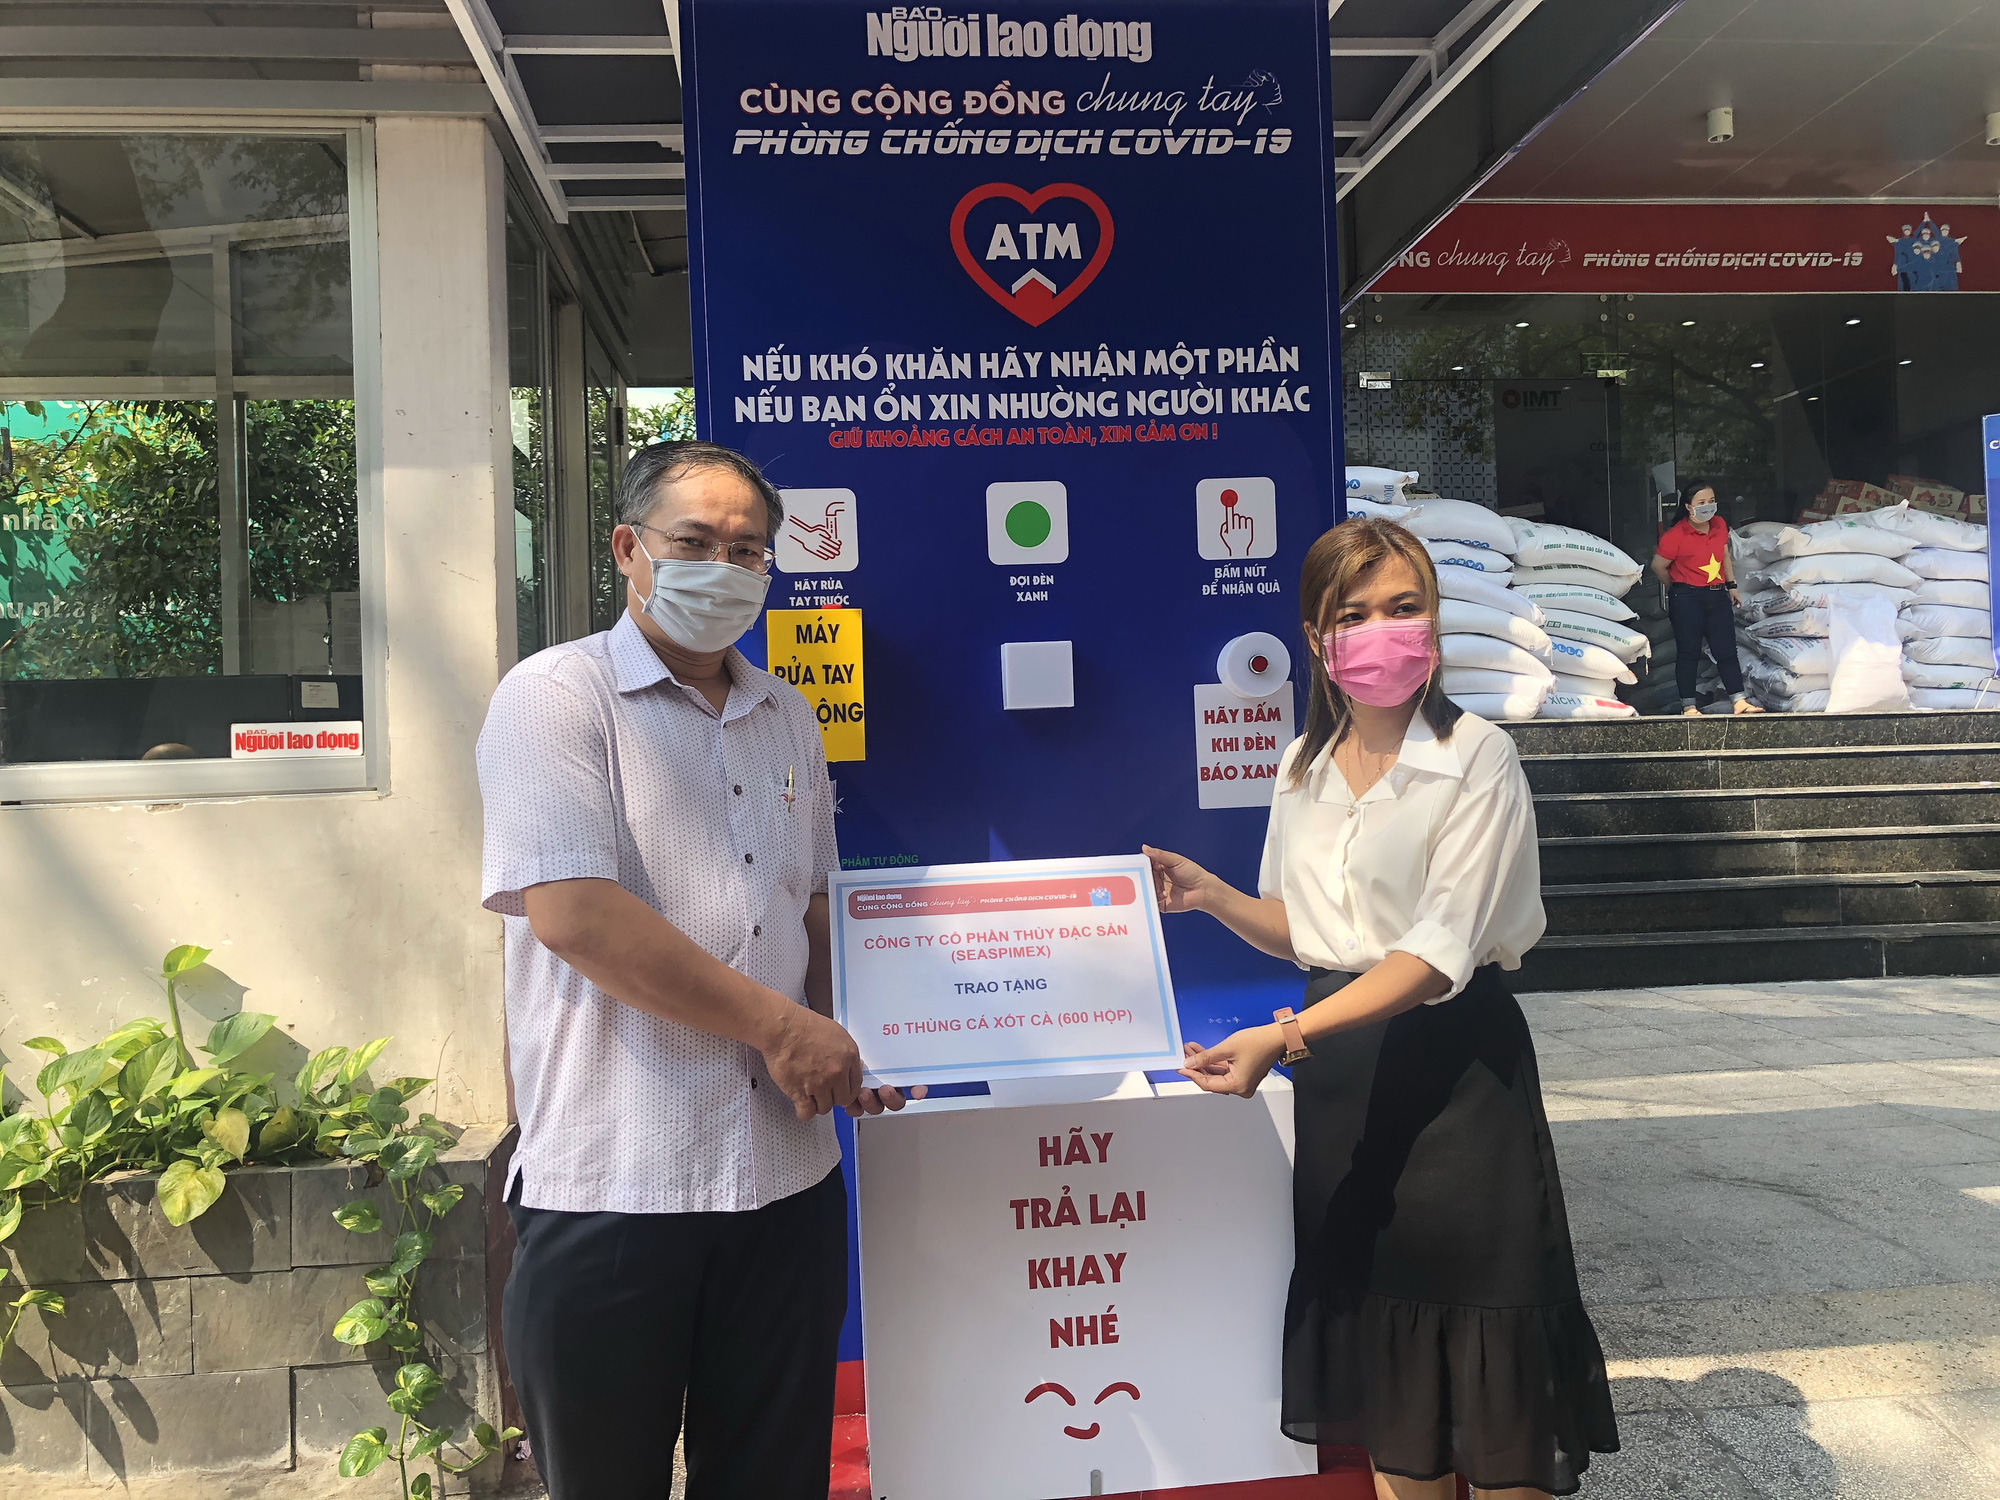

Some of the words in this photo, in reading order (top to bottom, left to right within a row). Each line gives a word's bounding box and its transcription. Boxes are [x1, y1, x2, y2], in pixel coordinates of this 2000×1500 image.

[892, 6, 942, 20] BÁO
[866, 13, 981, 62] Người
[986, 14, 1048, 58] lao
[1053, 14, 1153, 63] động
[739, 82, 841, 115] CÙNG
[851, 83, 953, 122] CỘNG
[963, 79, 1066, 115] ĐỒNG
[1076, 71, 1188, 126] chung
[1197, 75, 1258, 126] tay
[732, 121, 870, 155] PHÒNG
[880, 118, 1012, 155] CHỐNG
[1014, 129, 1105, 162] DỊCH
[1109, 128, 1293, 155] COVID-19
[985, 223, 1083, 261] ATM
[1391, 250, 1430, 267] NG
[1437, 239, 1510, 275] chung
[1515, 242, 1555, 275] tay
[1583, 250, 1650, 267] PHÒNG
[1655, 247, 1720, 267] CHỐNG
[1722, 252, 1767, 270] DỊCH
[1768, 252, 1864, 267] COVID-19
[742, 343, 801, 381] NẾU
[810, 346, 878, 381] KHÓ
[886, 346, 972, 380] KHĂN
[979, 345, 1043, 379] HÃY
[1050, 343, 1136, 382] NHẬN
[1144, 341, 1210, 380] MỘT
[1217, 336, 1299, 374] PHẦN
[734, 385, 793, 423] NẾU
[801, 394, 866, 427] BẠN
[873, 382, 921, 421] ỔN
[929, 393, 980, 421] XIN
[988, 384, 1119, 420] NHƯỜNG
[1127, 381, 1224, 417] NGƯỜI
[1231, 379, 1311, 414] KHÁC
[1523, 391, 1561, 407] IMT
[828, 426, 863, 448] GIỮ
[866, 424, 950, 448] KHOẢNG
[954, 424, 1003, 446] CÁCH
[1006, 427, 1034, 446] AN
[1037, 422, 1096, 447] TOÀN,
[1100, 425, 1132, 443] XIN
[1135, 419, 1176, 441] CẢM
[1179, 422, 1209, 440] ƠN
[3, 507, 58, 531] nhà
[1009, 574, 1030, 588] ĐỢI
[1032, 572, 1054, 586] ĐÈN
[1214, 563, 1240, 579] BẤM
[1244, 563, 1267, 578] NÚT
[794, 578, 818, 591] HÃY
[820, 576, 844, 590] RỬA
[1202, 579, 1218, 595] ĐỂ
[1222, 580, 1254, 597] NHẬN
[1257, 579, 1281, 595] QUÀ
[789, 596, 811, 606] TAY
[813, 592, 850, 606] TRƯỚC
[1016, 591, 1048, 602] XANH
[795, 616, 840, 644] MÁY
[822, 663, 854, 685] TAY
[815, 697, 864, 731] ỘNG
[1204, 705, 1239, 725] HÃY
[1243, 702, 1282, 723] BẤM
[287, 731, 314, 750] lao
[316, 731, 359, 751] động
[1211, 737, 1239, 753] KHI
[1243, 732, 1276, 751] ĐÈN
[1200, 762, 1238, 781] BÁO
[1242, 763, 1280, 779] XAN
[872, 856, 887, 867] TỰ
[889, 853, 919, 866] ĐỘNG
[857, 903, 879, 911] CÙNG
[881, 901, 903, 911] CỘNG
[864, 934, 910, 949] CÔNG
[915, 935, 934, 947] TY
[966, 929, 1009, 944] PHẦN
[1013, 926, 1055, 941] THỦY
[1059, 924, 1092, 940] ĐẶC
[1096, 923, 1128, 937] SẢN
[951, 945, 1051, 964] (SEASPIMEX)
[954, 981, 999, 995] TRAO
[1003, 977, 1048, 994] TẶNG
[882, 1023, 900, 1036] 50
[904, 1018, 961, 1034] THÙNG
[966, 1014, 989, 1030] CÁ
[1030, 1010, 1053, 1026] CÀ
[1057, 1011, 1089, 1027] (600
[1093, 1008, 1133, 1025] HỘP)
[1038, 1126, 1114, 1167] HÃY
[1009, 1184, 1080, 1230] TRẢ
[1089, 1190, 1146, 1229] LẠI
[1027, 1252, 1128, 1290] KHAY
[1049, 1304, 1120, 1349] NHÉ
